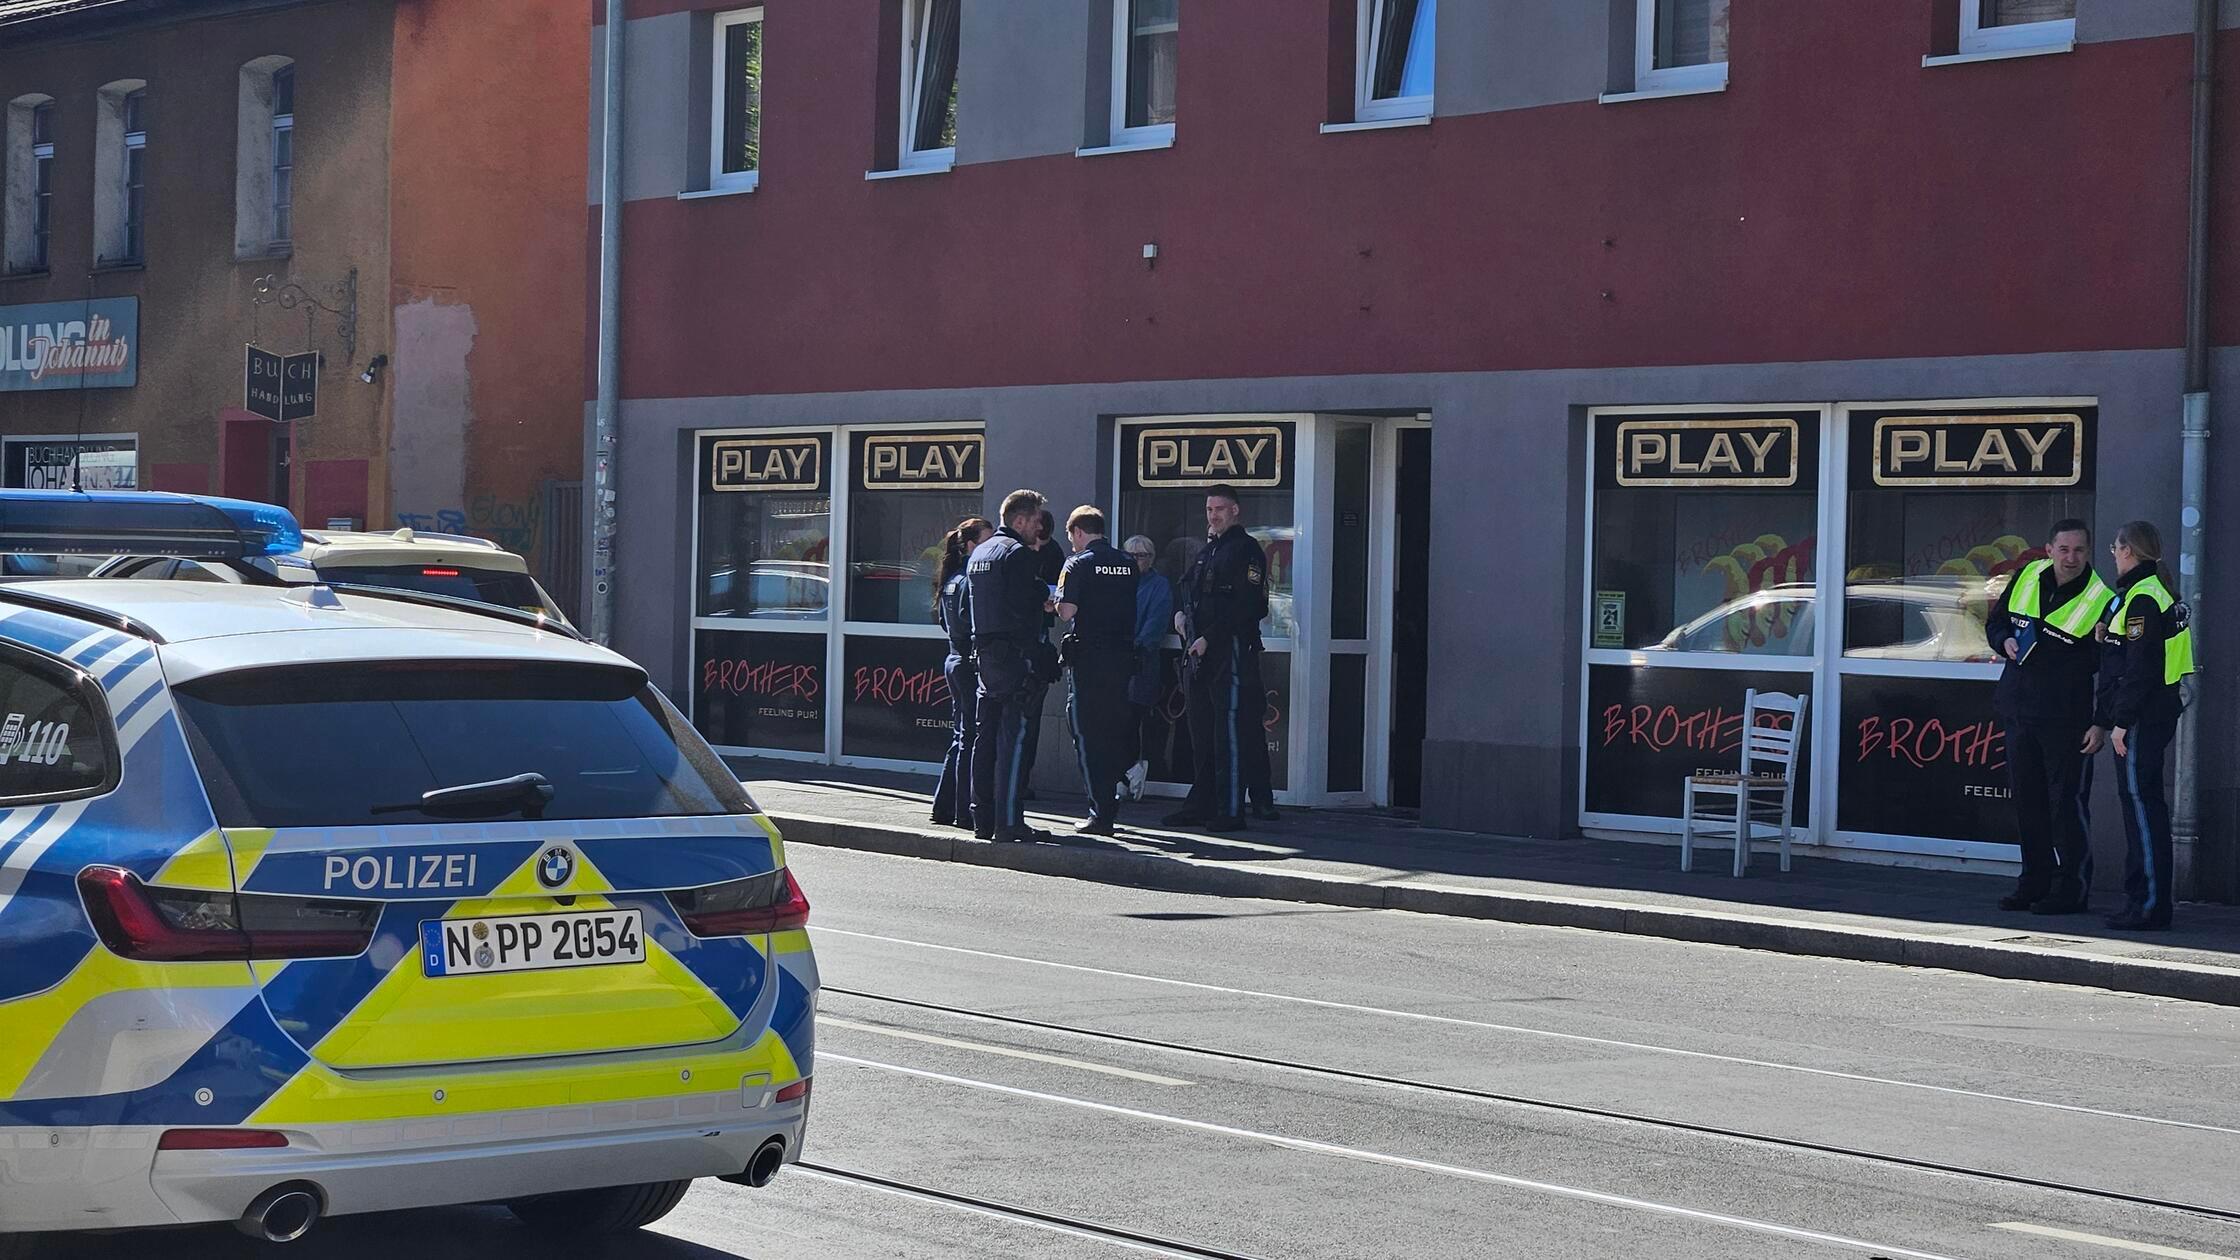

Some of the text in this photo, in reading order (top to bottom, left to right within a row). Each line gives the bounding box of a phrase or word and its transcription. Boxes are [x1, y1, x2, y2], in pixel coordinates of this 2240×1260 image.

[0, 314, 111, 371] LUNG in
[28, 335, 128, 379] Johannis
[252, 357, 312, 379] BUCH
[250, 387, 313, 406] HANDLUNG
[721, 448, 810, 481] PLAY
[873, 445, 974, 479] PLAY
[1150, 438, 1269, 476] PLAY
[1631, 431, 1781, 474] PLAY
[1889, 428, 2062, 473] PLAY
[1095, 565, 1131, 576] POLIZEI
[703, 658, 818, 702] BROTHERS
[854, 666, 952, 706] BROTHE
[758, 707, 818, 719] FEELING PUR!
[18, 720, 69, 765] 110
[1964, 785, 2012, 799] FEELI
[324, 854, 477, 890] POLIZEI
[543, 848, 572, 862] BMW
[446, 916, 638, 967] N PP 2054
[430, 954, 439, 966] D
